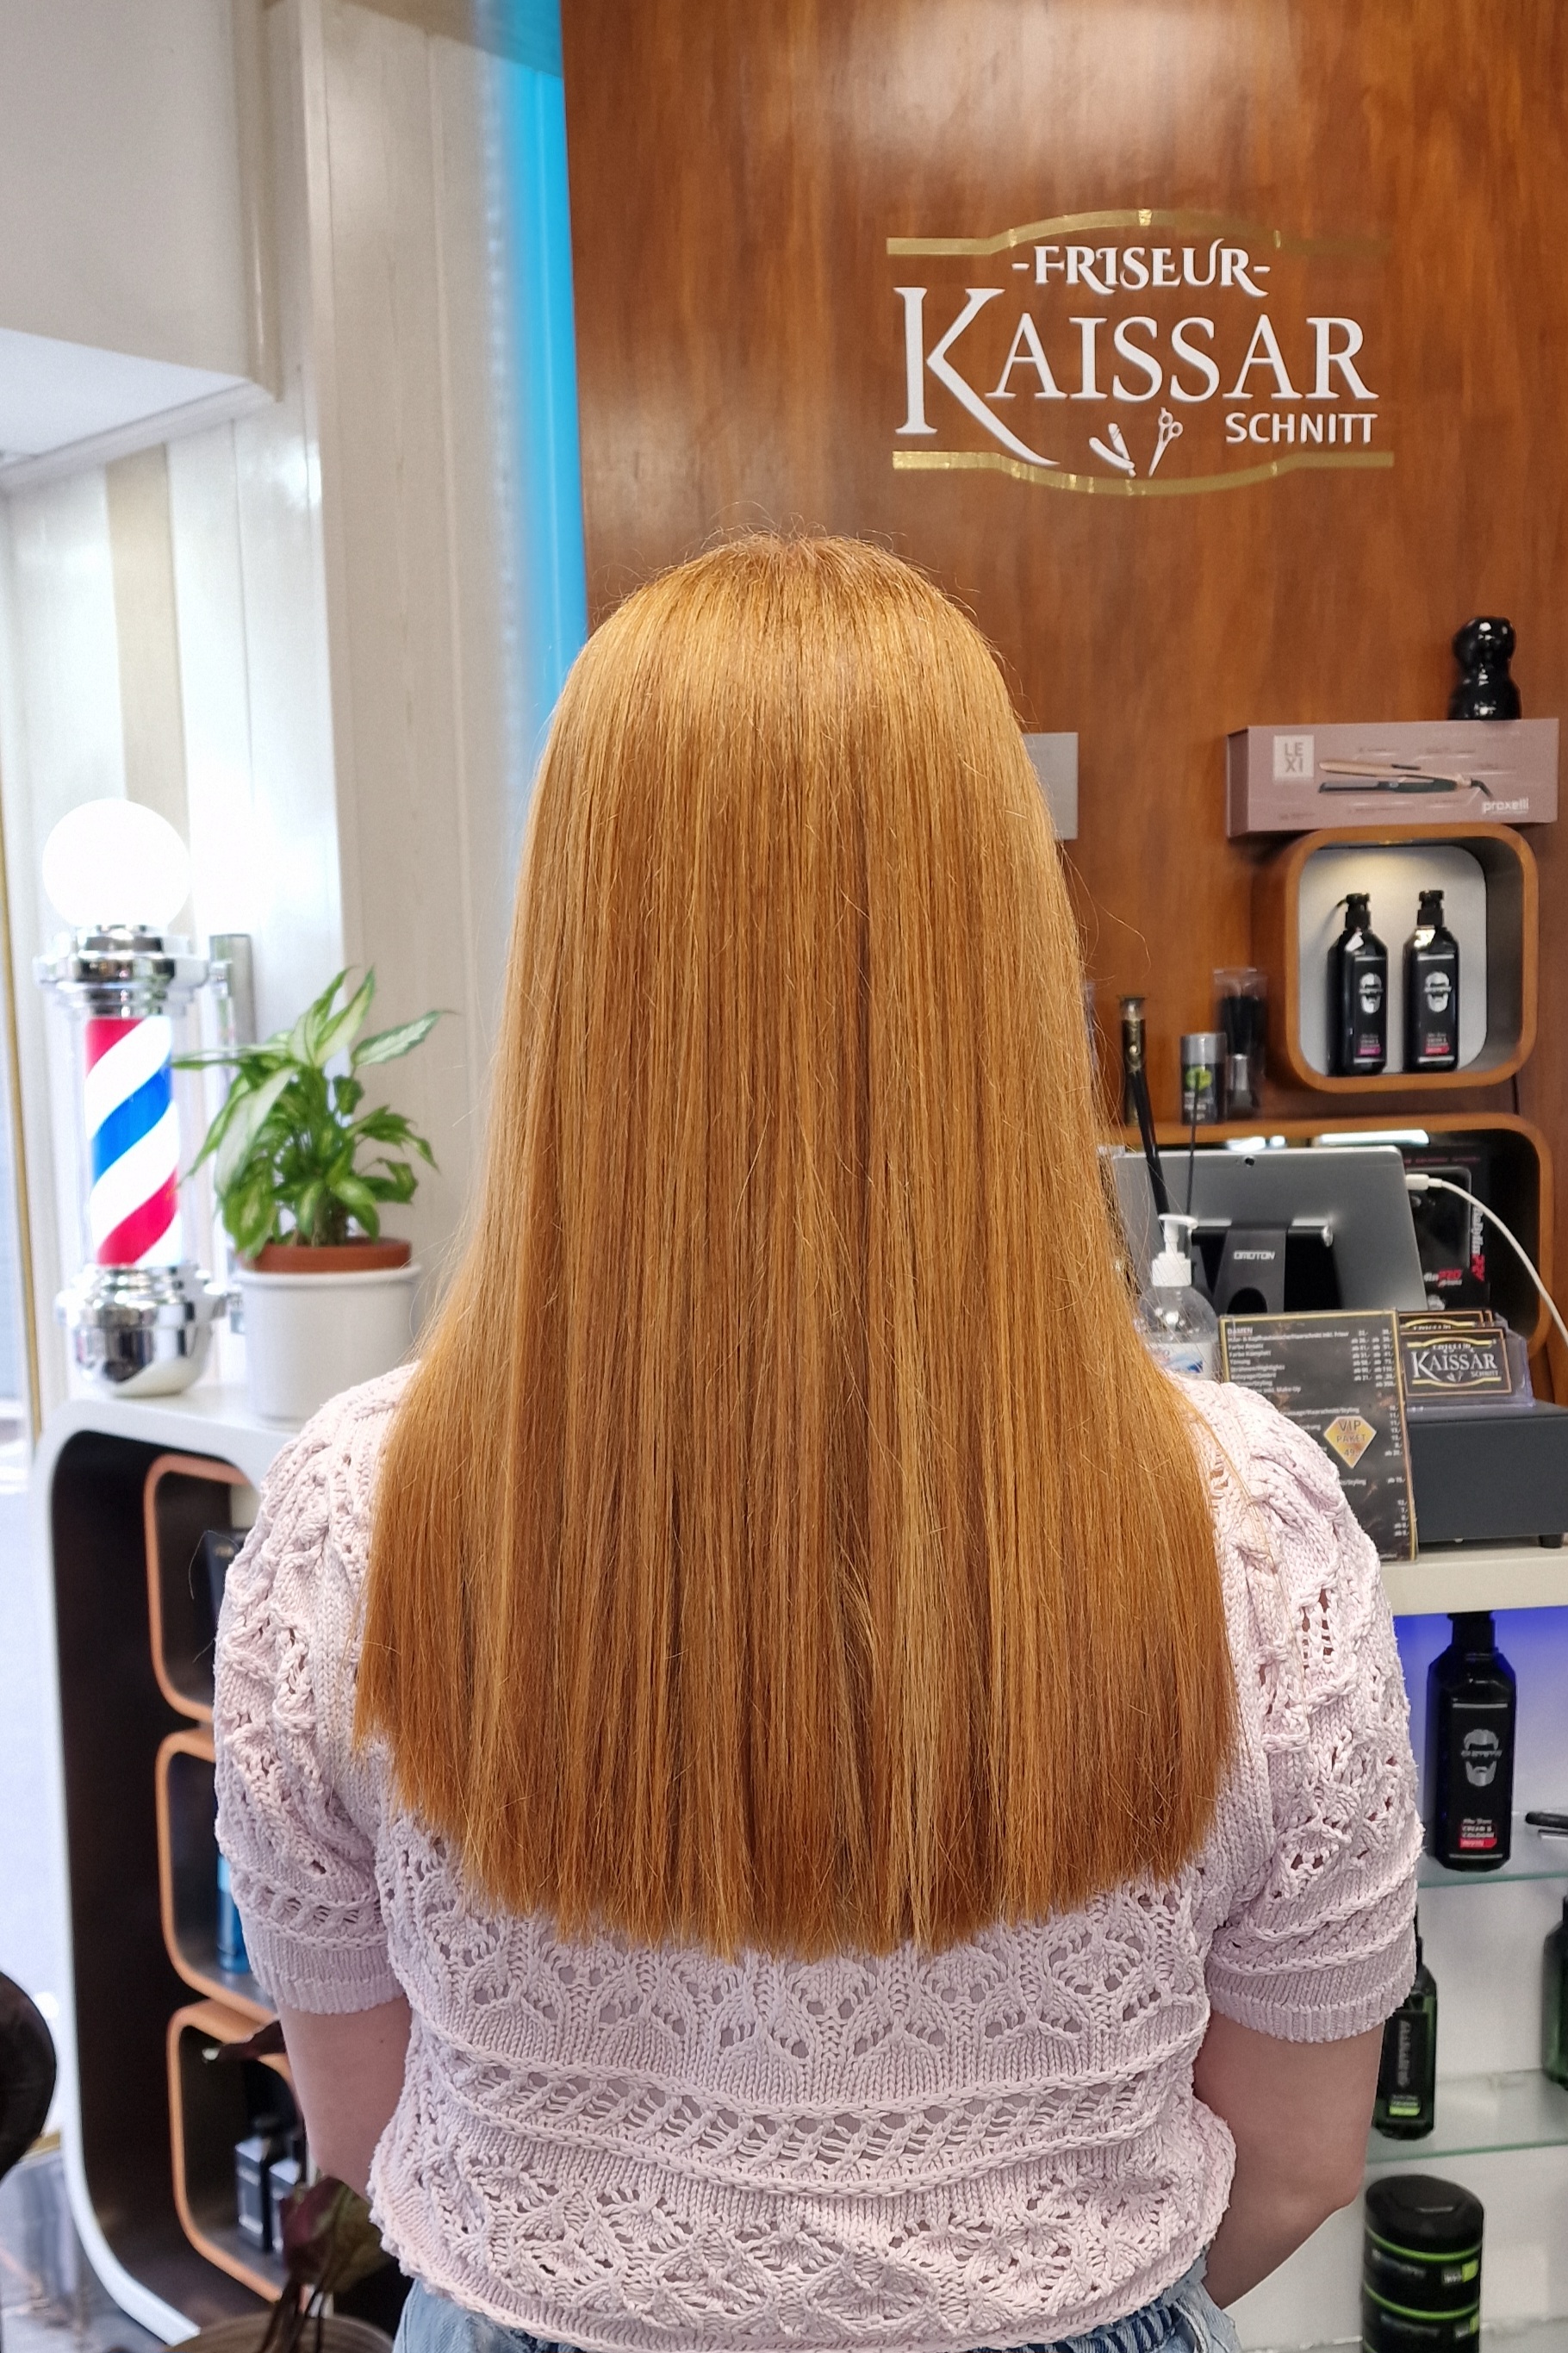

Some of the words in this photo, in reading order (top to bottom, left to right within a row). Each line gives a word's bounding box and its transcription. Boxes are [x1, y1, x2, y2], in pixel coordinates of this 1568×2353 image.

[893, 286, 1378, 466] KAISSAR
[1225, 413, 1378, 445] SCHNITT
[1482, 797, 1529, 813] proxelli
[1233, 1250, 1275, 1260] OMOTON
[1410, 1350, 1497, 1382] KAISSAR
[1338, 1420, 1361, 1432] VIP
[1336, 1434, 1366, 1443] PAKET
